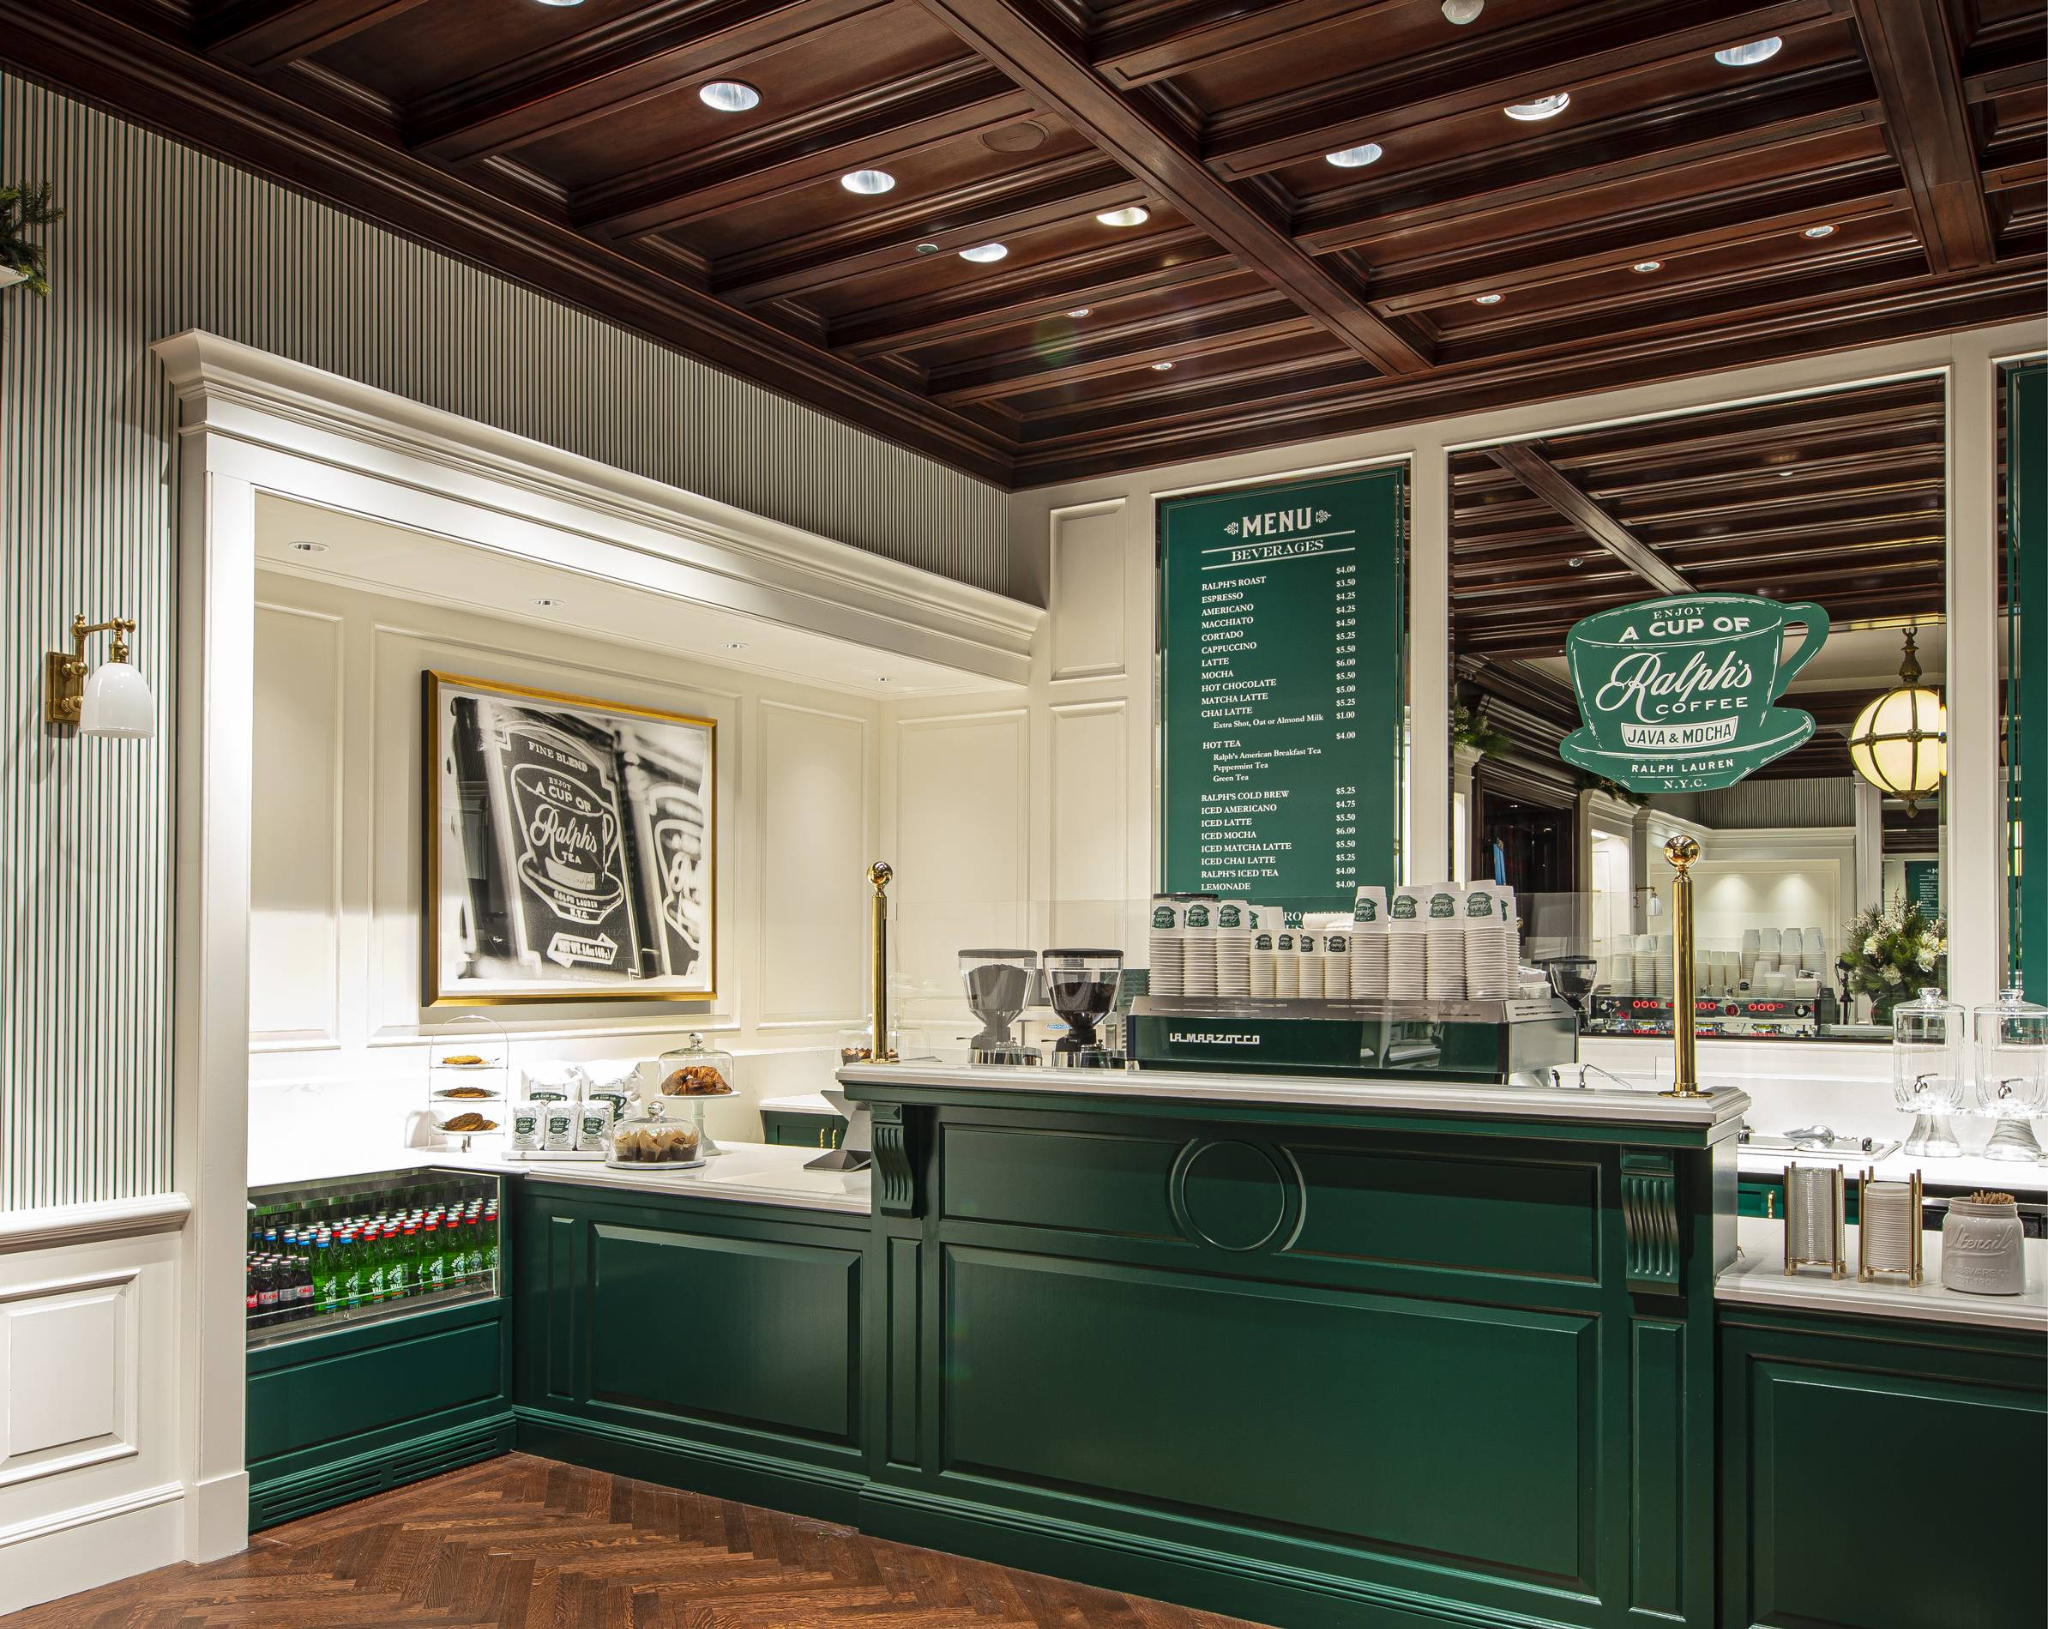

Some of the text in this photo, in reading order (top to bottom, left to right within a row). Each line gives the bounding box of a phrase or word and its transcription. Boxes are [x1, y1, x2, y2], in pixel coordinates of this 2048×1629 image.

[1242, 507, 1312, 538] MENU
[1231, 539, 1324, 562] BEVERAGES
[1202, 565, 1355, 591] RALPH'S ROAST $4.00
[1202, 579, 1355, 604] ESPRESSO $3.50
[1201, 592, 1355, 616] AMERICANO $4.25
[1653, 607, 1705, 619] ENJOY
[1201, 605, 1355, 629] MACCHIATO $4.25
[1202, 619, 1355, 642] CORTADO $4.50
[1619, 617, 1750, 643] A CUP OF
[1202, 632, 1355, 654] CAPPUCCINO $5.25
[1202, 645, 1355, 667] LATTE $5.50
[1201, 658, 1355, 680] MOCHA $6.00
[1202, 672, 1355, 692] HOT CHOCOLATE $5.50
[1595, 650, 1752, 723] Ralph's
[1201, 685, 1355, 705] MATCHA LATTE $5.00
[1201, 698, 1355, 718] CHAI LATTE $5.25
[1656, 697, 1748, 715] COFFEE
[1234, 719, 1251, 727] Shot,
[1277, 716, 1305, 724] Almond
[1307, 714, 1324, 722] Milk
[1336, 711, 1355, 720] $1.00
[1203, 731, 1355, 750] HOT TEA $4.00
[1628, 723, 1732, 745] JAVA & MOCHA
[529, 741, 588, 772] FINE BLEND
[1213, 747, 1321, 762] Ralph's American Breakfast Tea
[1213, 764, 1253, 772] Peppermint
[1631, 759, 1734, 773] RALPH LAUREN
[535, 782, 546, 795] A
[549, 786, 573, 802] CUP
[1201, 786, 1355, 802] RALPH'S COLD BREW $5.25
[1663, 779, 1707, 789] N.Y.C.
[1201, 800, 1355, 815] ICED AMERICANO $4.75
[1224, 818, 1252, 827] LATTE
[1336, 813, 1355, 822] $5.50
[530, 804, 597, 864] Ralph's
[1224, 831, 1257, 840] MOCHA
[1336, 827, 1355, 836] $6.00
[1201, 840, 1355, 853] ICED MATCHA LATTE $5.50
[561, 851, 581, 864] TEA
[1201, 853, 1355, 866] ICED CHAI LATTE $5.25
[1201, 870, 1237, 878] RALPH'S
[1261, 869, 1279, 877] TEA
[1336, 867, 1355, 876] $4.00
[1201, 880, 1355, 891] LEMONADE $4.00
[1946, 1223, 2014, 1250] Utensil
